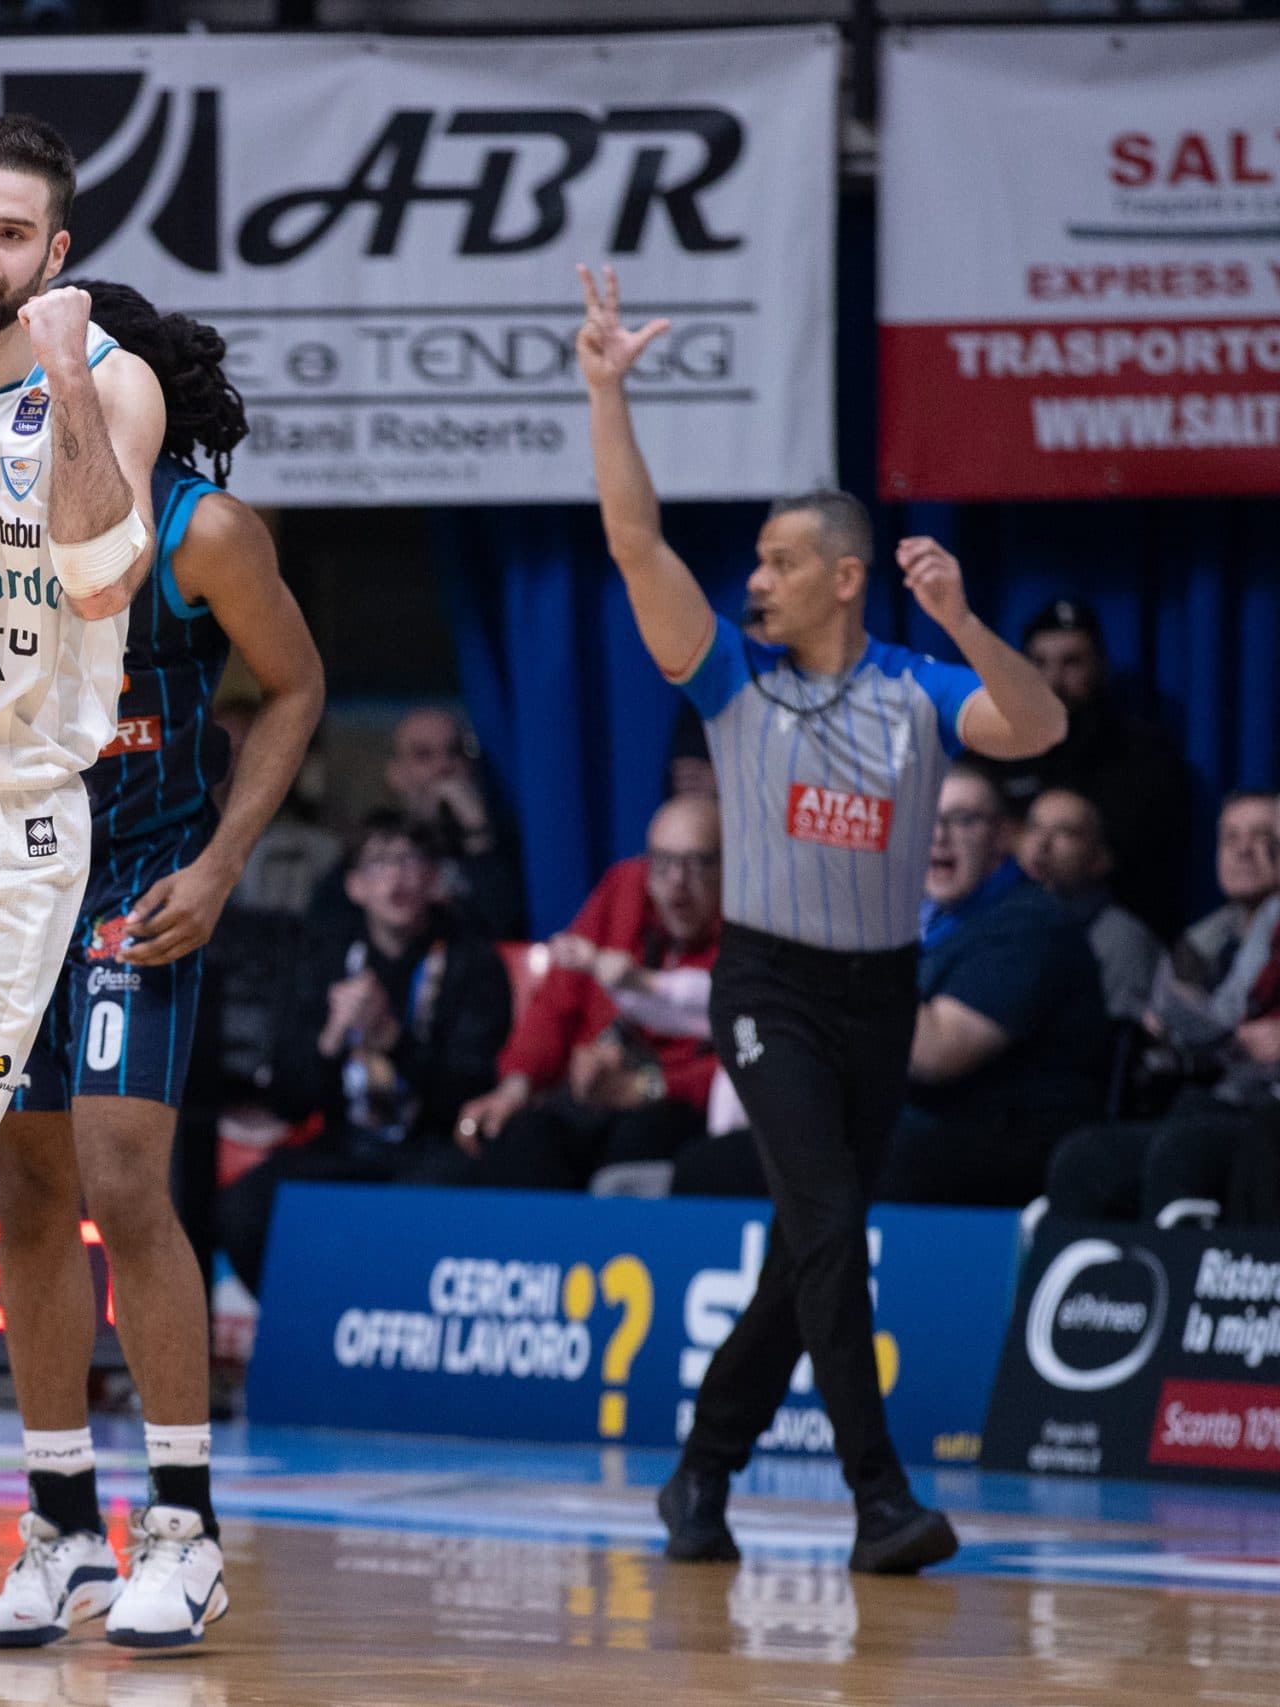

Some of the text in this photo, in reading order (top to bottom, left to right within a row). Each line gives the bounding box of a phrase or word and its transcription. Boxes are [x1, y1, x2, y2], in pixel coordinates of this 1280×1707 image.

[1109, 131, 1280, 187] SAL
[237, 107, 745, 268] ABR
[1027, 263, 1251, 301] EXPRESS
[20, 406, 43, 416] LBA
[370, 413, 566, 456] Roberto
[86, 1000, 125, 1072] 0
[430, 1257, 561, 1319] CERCHI
[334, 1308, 442, 1372] OFFRI
[442, 1316, 591, 1381] LAVORO
[1162, 1400, 1241, 1449] Sconto
